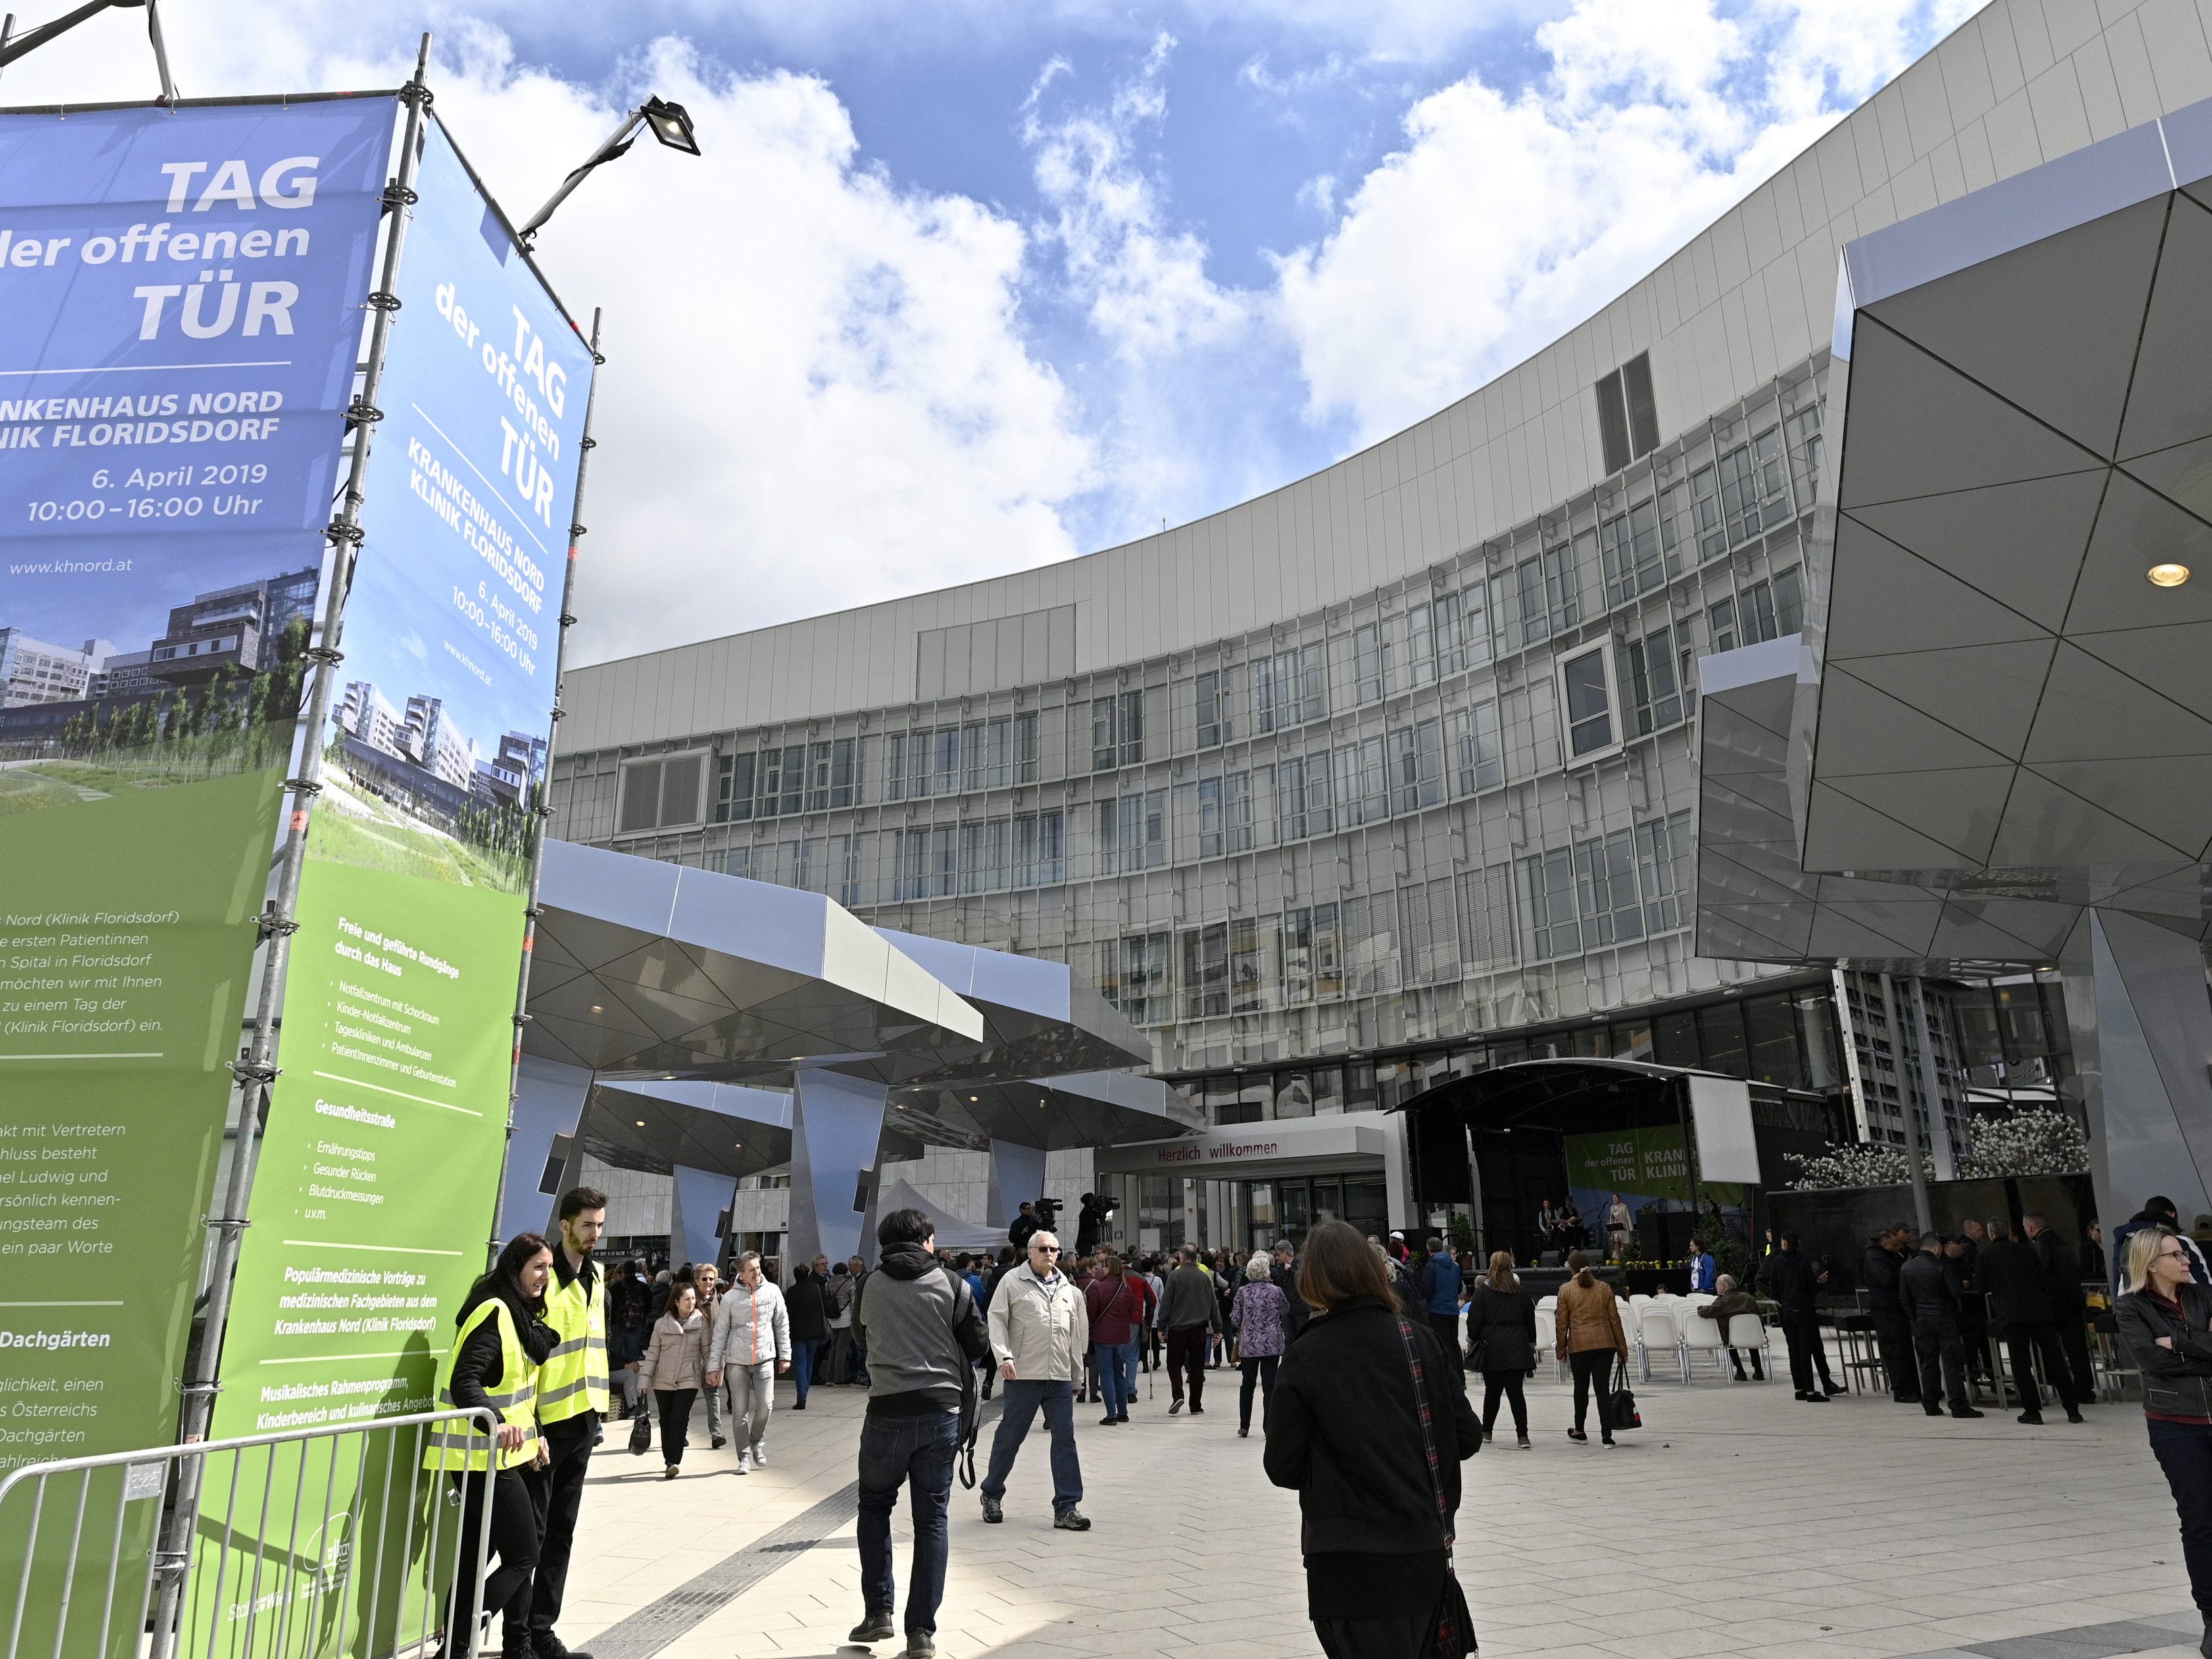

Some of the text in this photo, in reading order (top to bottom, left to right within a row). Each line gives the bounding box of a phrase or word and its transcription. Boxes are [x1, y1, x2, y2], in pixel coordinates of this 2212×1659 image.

[161, 156, 320, 213] TAG
[81, 222, 310, 265] offenen
[134, 269, 299, 341] TÜR
[436, 282, 560, 462] der offenen
[512, 303, 566, 420] TAG
[0, 391, 283, 422] NKENHAUS NORD
[52, 418, 280, 447] FLORIDSDORF
[92, 464, 268, 491] 6. April 2019
[501, 414, 554, 529] TÜR
[213, 495, 263, 515] Uhr
[408, 435, 545, 592] KRANKENHAUS NORD
[410, 468, 542, 614] KLINIK FLORIDSDORF
[10, 559, 133, 574] www.khnord.at
[478, 580, 538, 650] 6. April 2019
[443, 639, 492, 687] www.khnord.at
[519, 648, 536, 676] Uhr
[6, 914, 43, 926] Nord
[45, 912, 91, 926] (Klinik
[94, 911, 180, 924] Floridsdorf)
[12, 935, 56, 947] ersten
[60, 934, 149, 946] Patientinnen
[338, 916, 460, 979] Freie und geführte Rundgänge
[10, 956, 51, 970] Spital
[55, 956, 68, 967] in
[72, 954, 153, 967] Floridsdorf
[335, 940, 402, 977] durch das Haus
[0, 976, 162, 990] möchten wir mit Ihnen
[2, 997, 128, 1012] zu einem Tag der
[339, 980, 440, 1026] Notfallzentrum mit Schockraum
[5, 1020, 49, 1035] (Klinik
[52, 1019, 136, 1033] Floridsdorf)
[139, 1018, 163, 1031] ein.
[337, 1000, 412, 1035] Kinder-Notfallzentrum
[335, 1020, 433, 1062] Tageskliniken und Ambulanzen
[399, 1062, 412, 1074] und
[315, 1097, 396, 1129] Gesundheitsstraße
[22, 1124, 47, 1137] mit
[52, 1124, 126, 1137] Vertretern
[0, 1146, 98, 1160] hluss besteht
[317, 1140, 376, 1163] Ernährungstipps
[1158, 1142, 1278, 1162] Herzlich willkommen
[1608, 1141, 1633, 1156] TAG
[313, 1162, 377, 1183] Gesunder Rücken
[1585, 1156, 1634, 1168] der offenen
[20, 1170, 74, 1185] Ludwig
[79, 1169, 109, 1183] und
[1611, 1167, 1636, 1182] TÜR
[62, 1192, 121, 1206] kennen-
[309, 1183, 384, 1206] Blutdruckmessungen
[72, 1216, 99, 1230] des
[304, 1208, 327, 1220] u.v.m.
[2, 1240, 114, 1256] ein paar Worte
[285, 1266, 426, 1288] Populärmedizinische Vorträge zu
[279, 1292, 437, 1311] medizinischen Fachgebieten aus dem
[274, 1316, 437, 1335] Krankenhaus Nord (Klinik Floridsdorf)
[0, 1330, 111, 1351] Dachgärten
[64, 1377, 104, 1391] einen
[260, 1377, 409, 1403] Musikalisches Rahmenprogramm,
[12, 1400, 98, 1417] Österreichs
[255, 1408, 327, 1431] Kinderbereich
[329, 1403, 347, 1420] und
[347, 1398, 401, 1420] kulinarisches
[0, 1428, 85, 1445] Dachgärten
